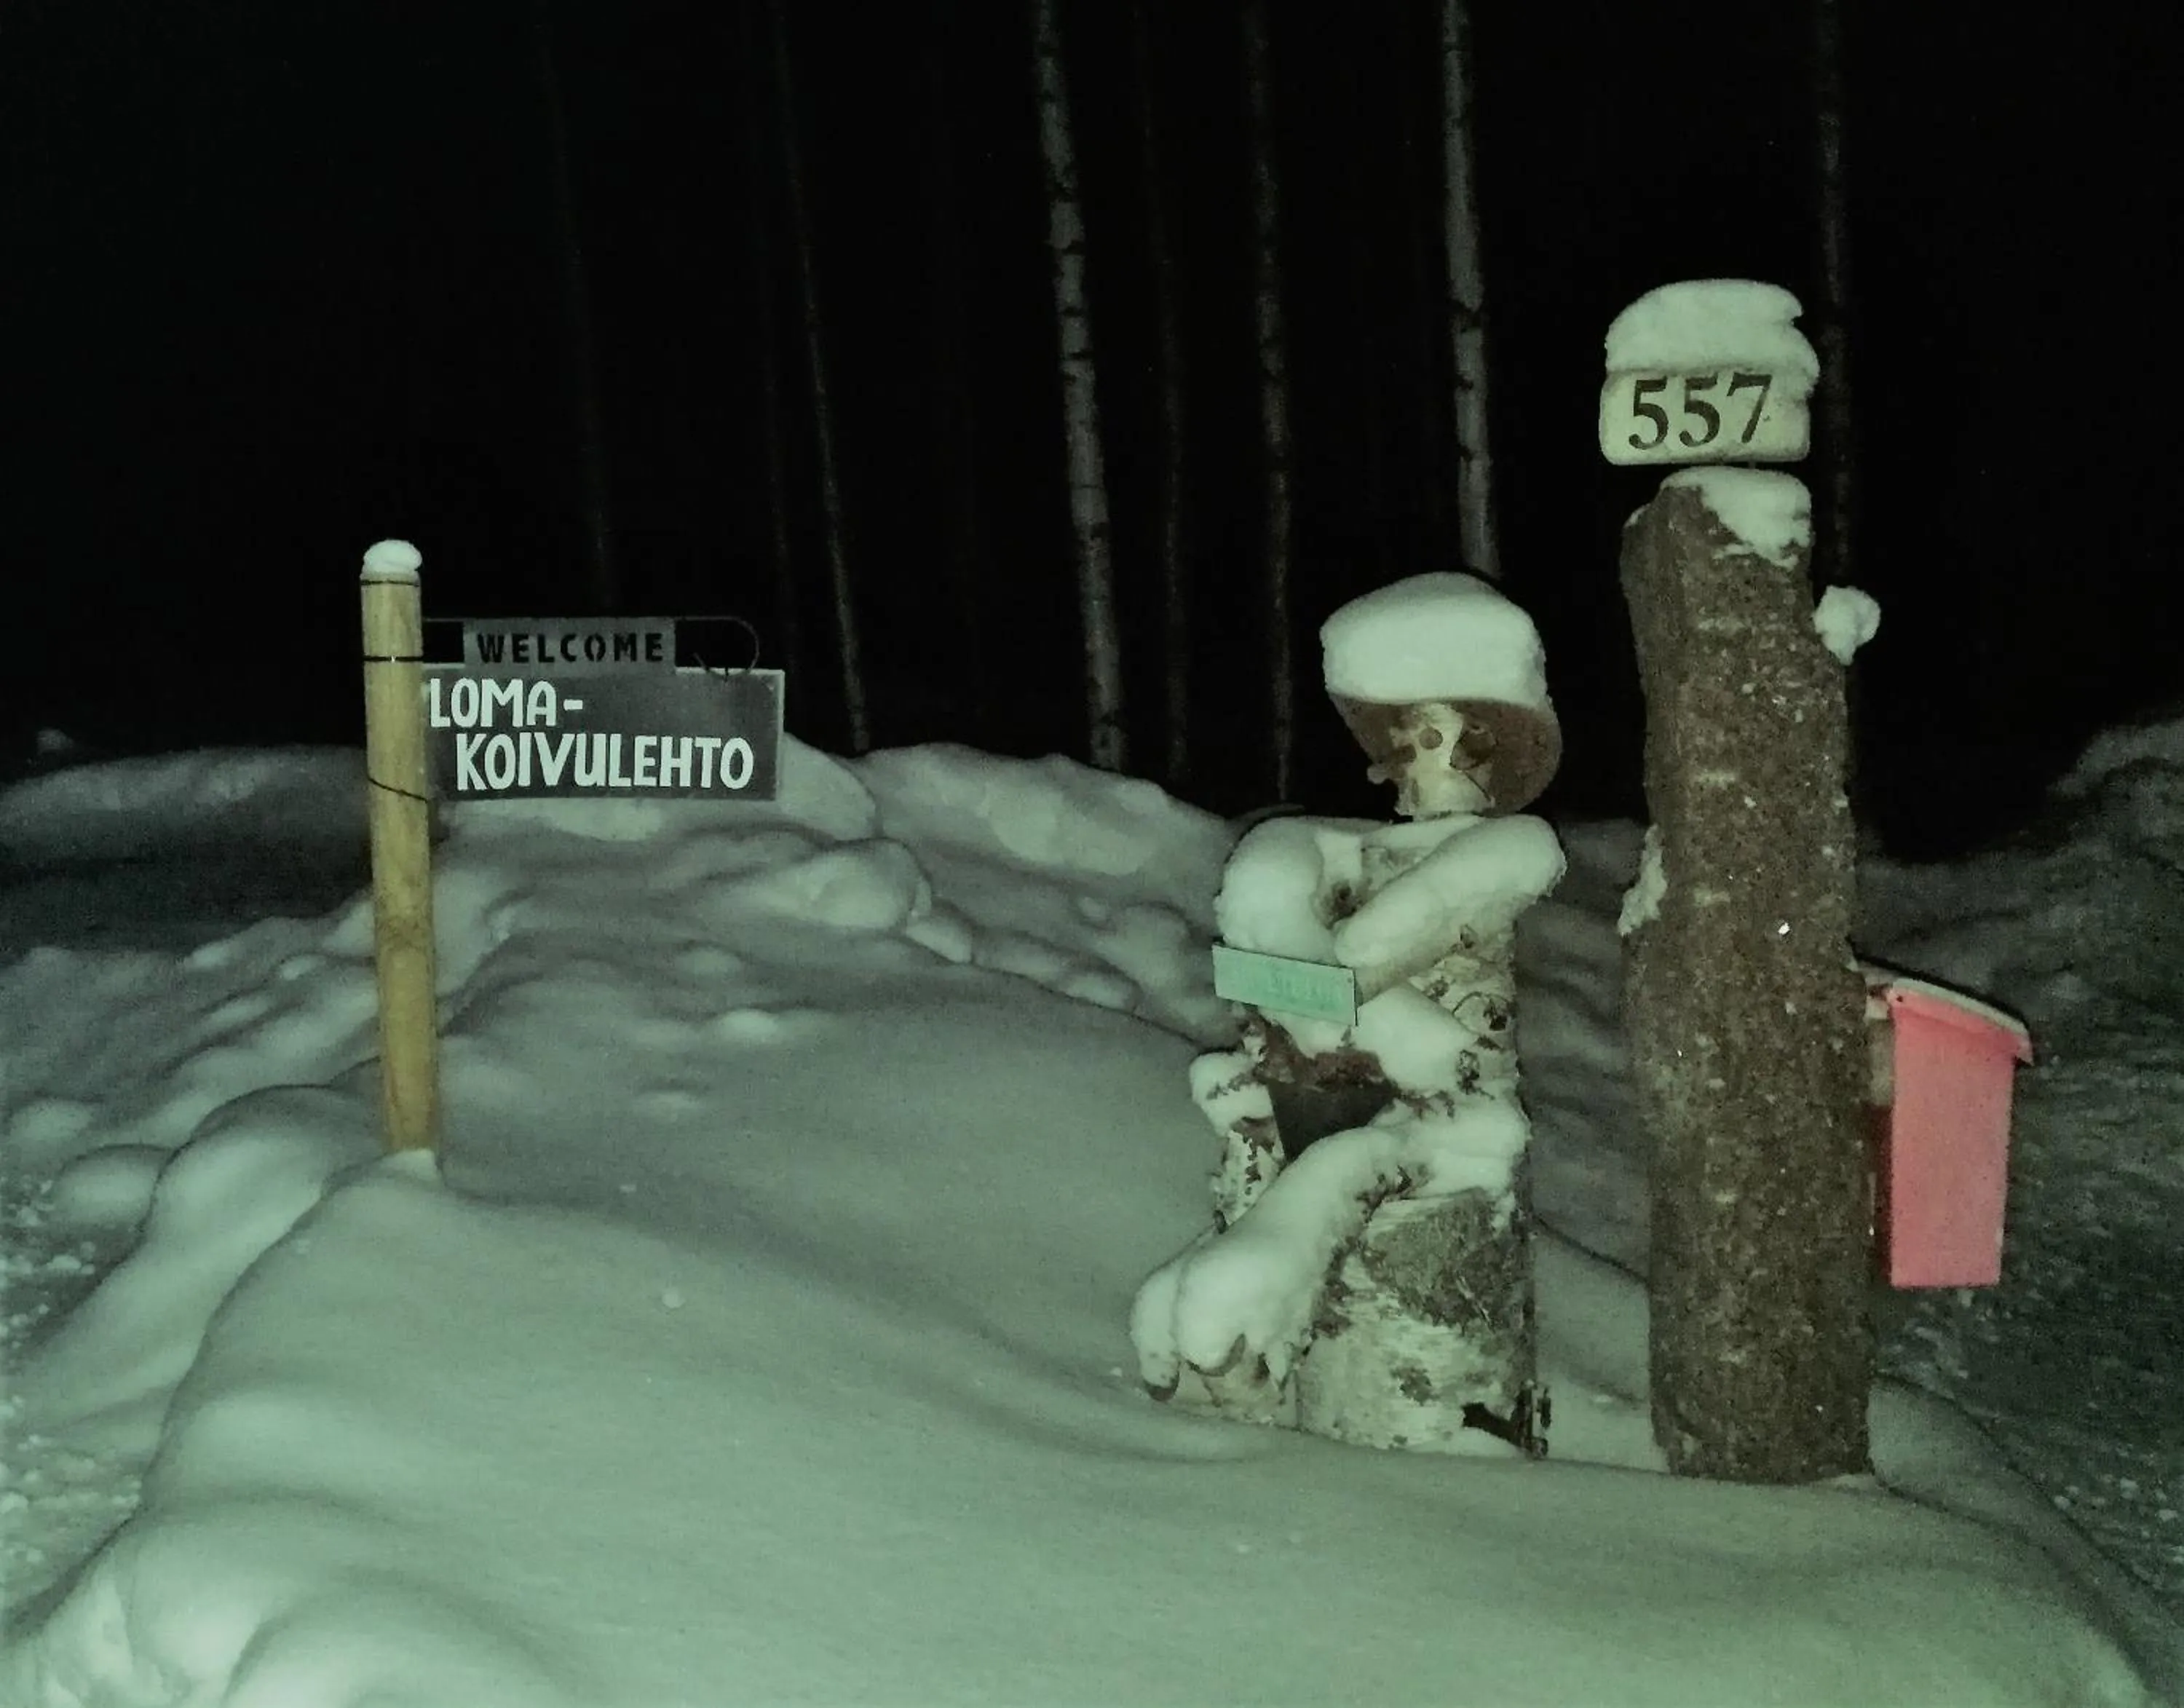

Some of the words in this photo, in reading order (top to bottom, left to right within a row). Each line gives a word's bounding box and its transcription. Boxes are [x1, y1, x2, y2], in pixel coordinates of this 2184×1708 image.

[1628, 371, 1773, 450] 557
[478, 632, 664, 664] WELCOME
[430, 678, 583, 728] LOMA-
[456, 732, 755, 791] KOIVULEHTO
